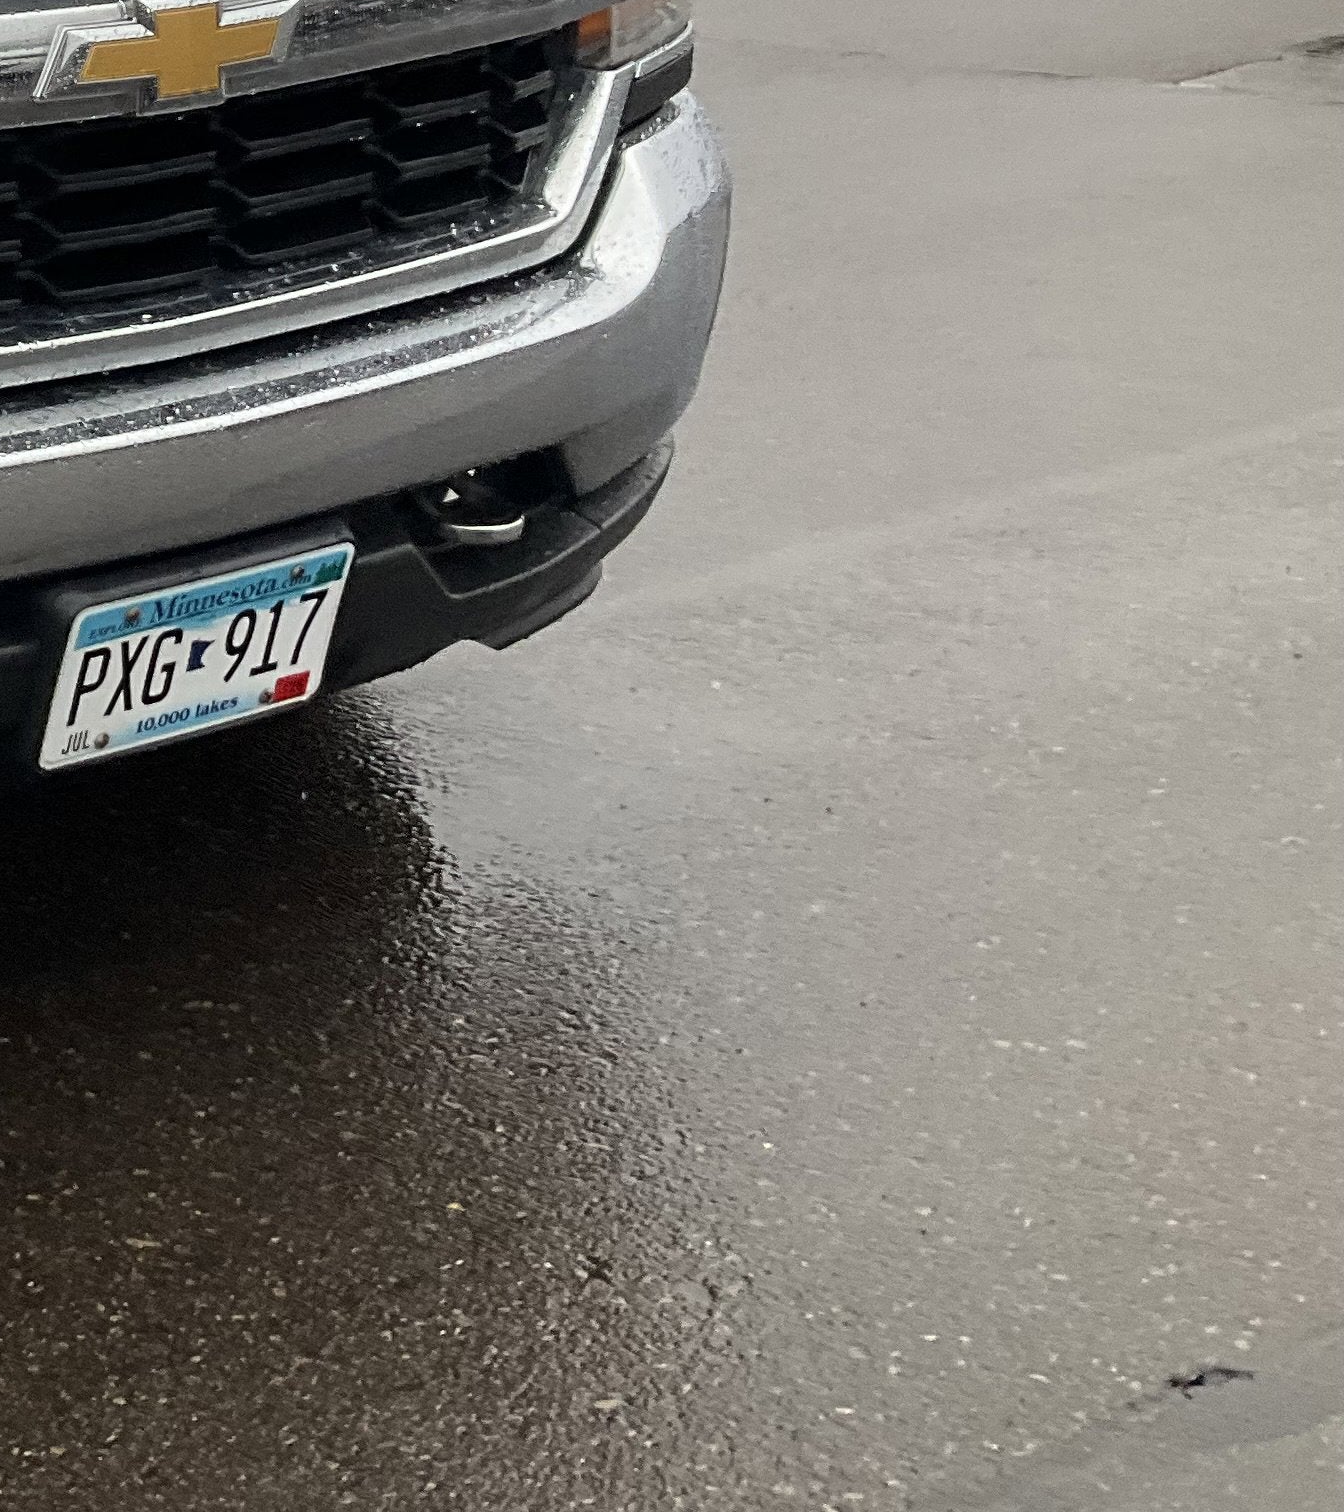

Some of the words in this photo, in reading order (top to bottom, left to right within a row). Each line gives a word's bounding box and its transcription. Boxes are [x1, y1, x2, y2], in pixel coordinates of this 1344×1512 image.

[66, 627, 184, 727] PXG
[223, 588, 330, 683] 917
[136, 707, 192, 734] 10,000
[195, 696, 240, 719] lakes
[61, 729, 91, 755] JUL
